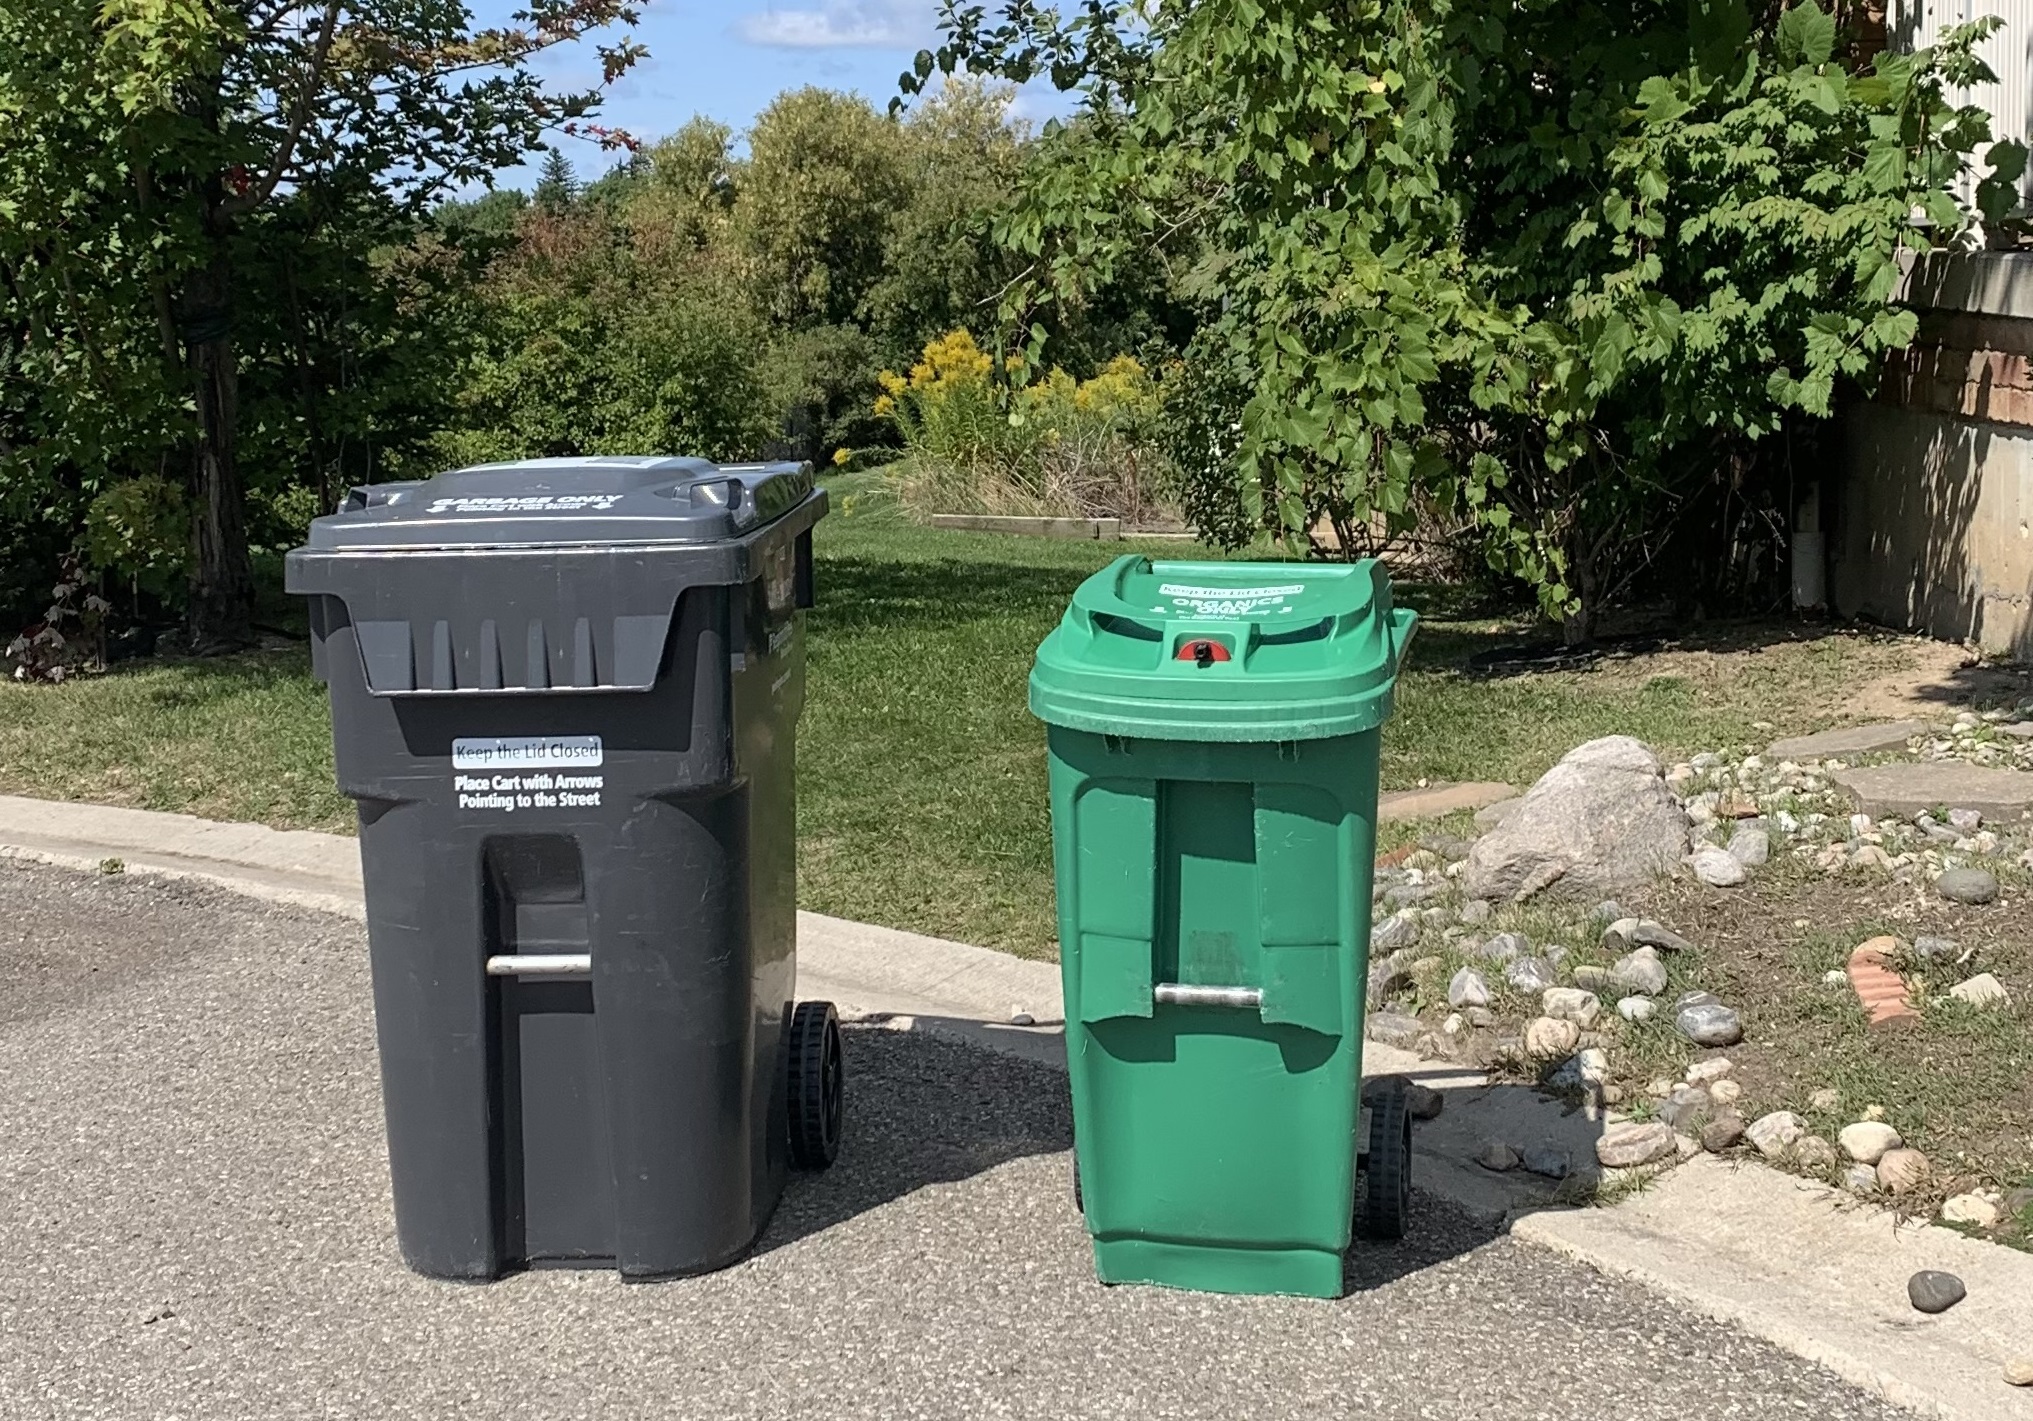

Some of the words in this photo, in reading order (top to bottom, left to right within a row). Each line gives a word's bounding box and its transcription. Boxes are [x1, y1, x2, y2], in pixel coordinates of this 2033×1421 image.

[433, 496, 554, 506] GARBAGE
[557, 494, 624, 504] ONLY
[1172, 596, 1285, 608] ORGANICS
[456, 745, 493, 763] Keep
[497, 743, 521, 760] the
[525, 742, 546, 759] Lid
[550, 741, 599, 758] Closed
[454, 775, 490, 791] Place
[491, 775, 521, 791] Cart
[522, 773, 554, 790] with
[555, 774, 604, 789] Arrows
[459, 792, 515, 812] Pointing
[516, 793, 532, 808] to
[533, 792, 557, 807] the
[558, 791, 601, 807] Street
